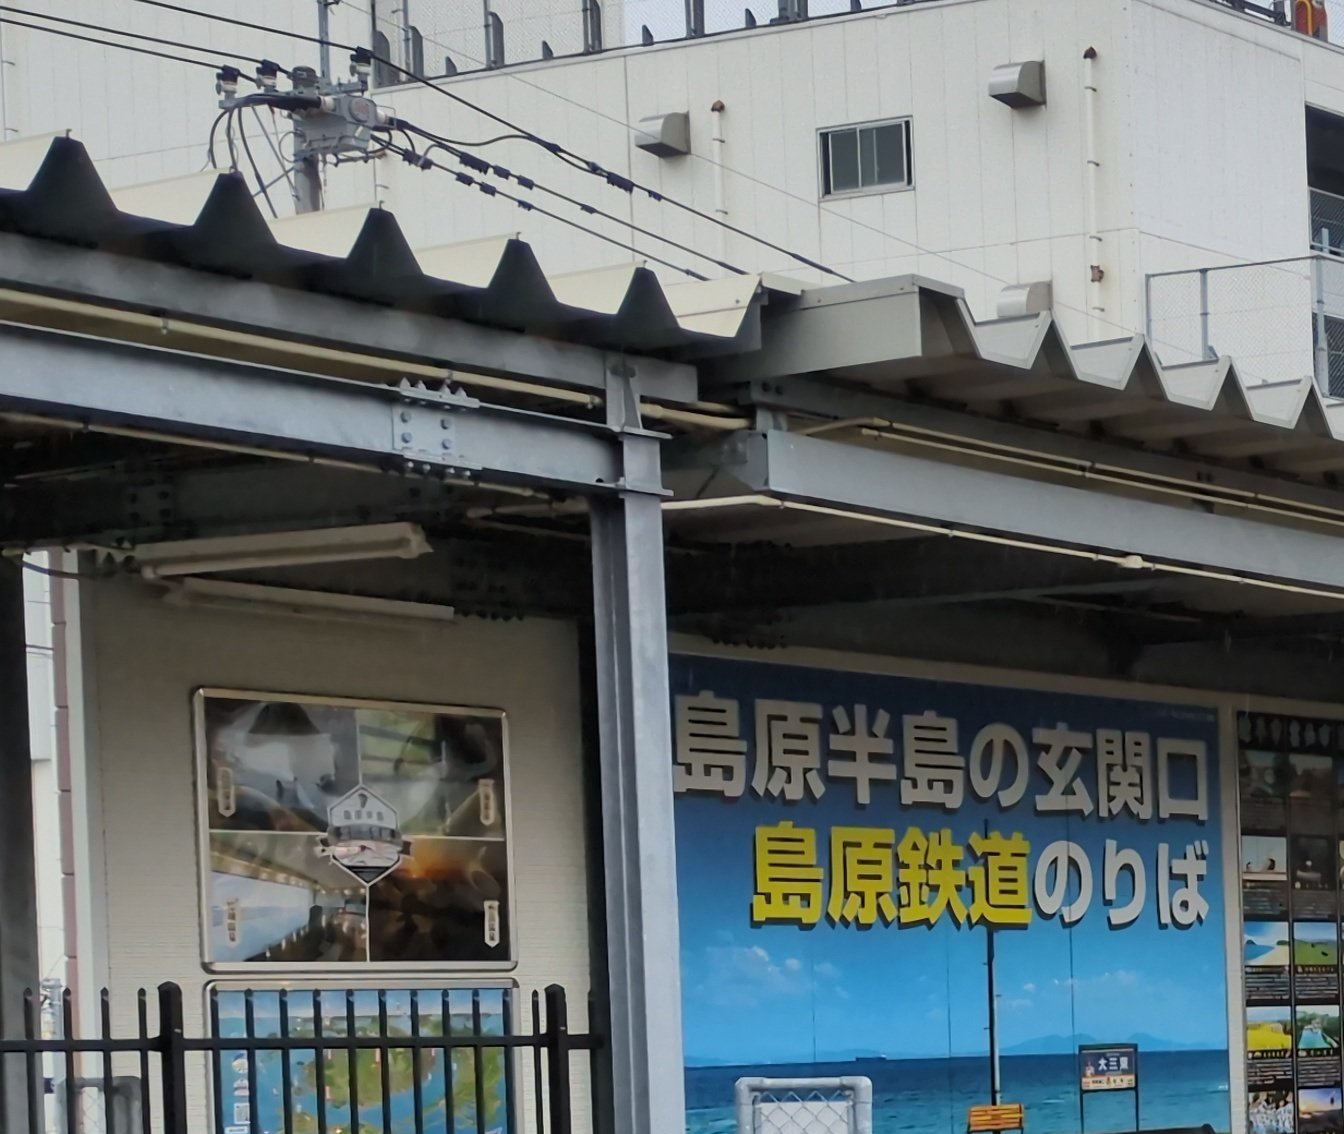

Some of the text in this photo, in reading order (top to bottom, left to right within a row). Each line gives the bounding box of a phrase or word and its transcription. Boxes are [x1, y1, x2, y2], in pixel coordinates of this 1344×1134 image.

[672, 690, 1209, 822] 島原半島の玄関口
[752, 821, 1210, 928] 島原鉄道のりば
